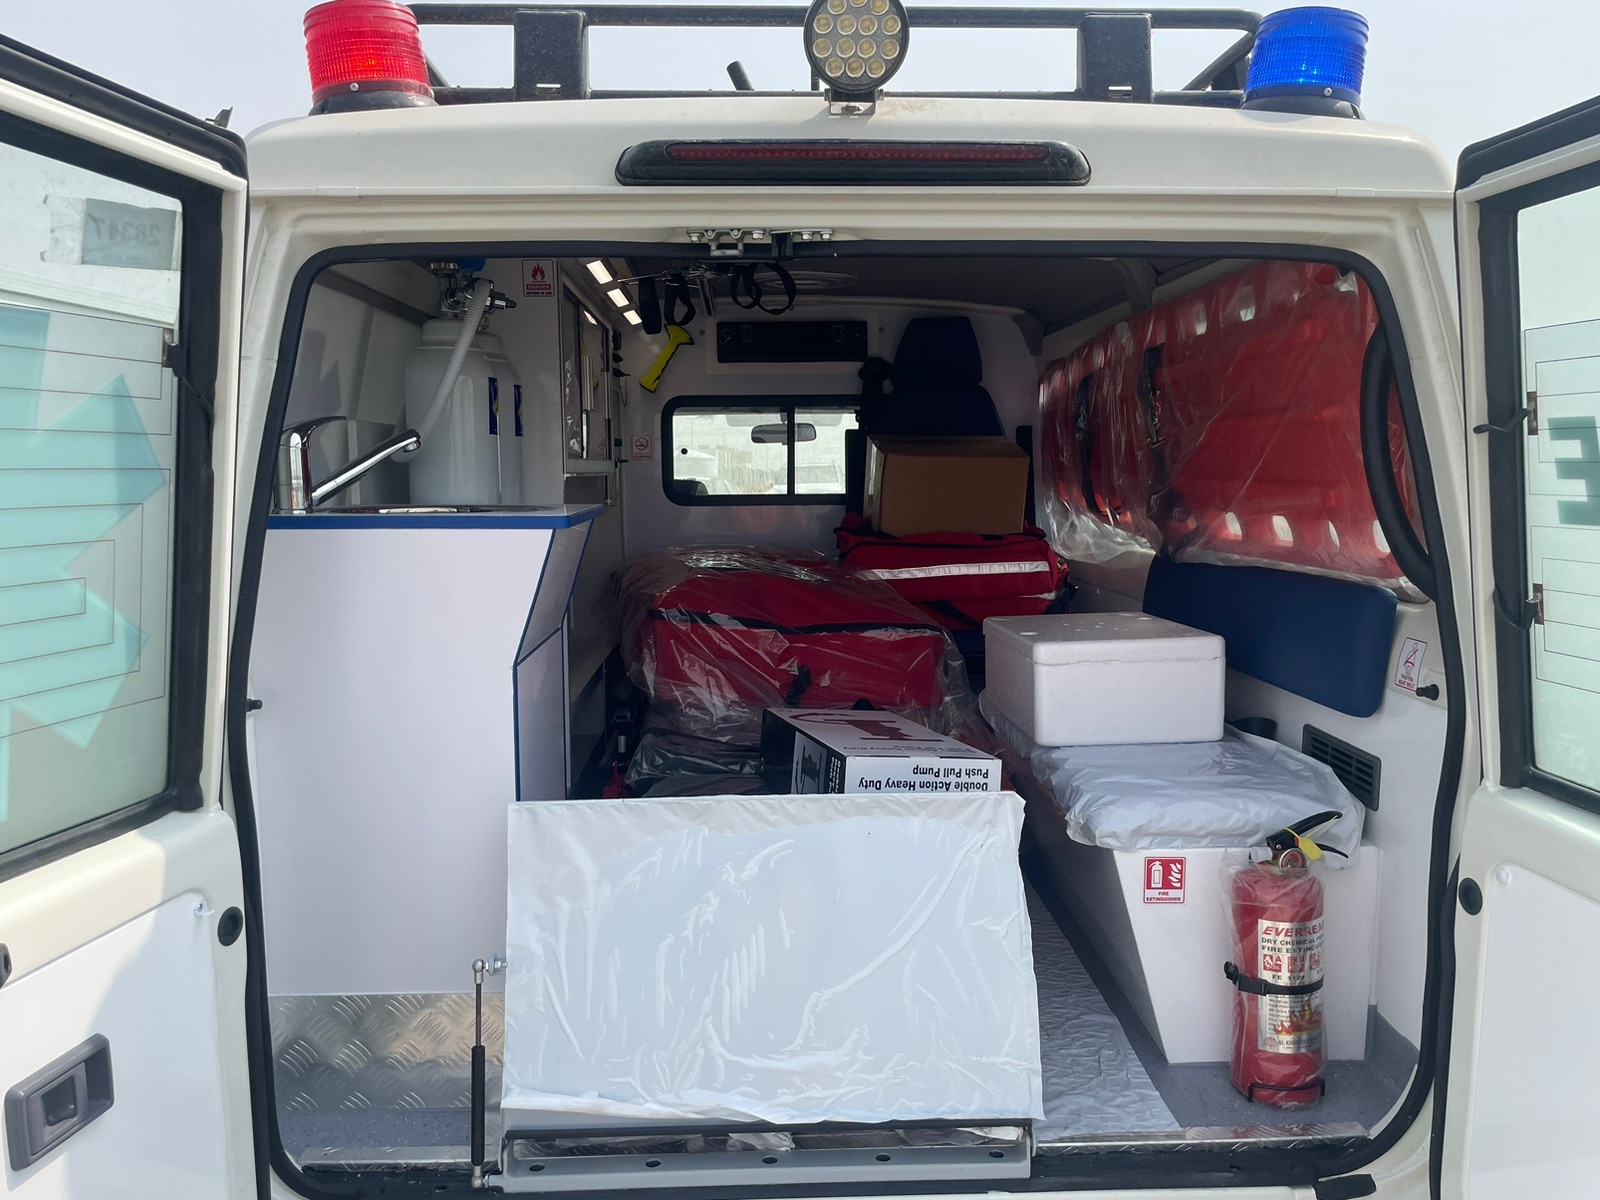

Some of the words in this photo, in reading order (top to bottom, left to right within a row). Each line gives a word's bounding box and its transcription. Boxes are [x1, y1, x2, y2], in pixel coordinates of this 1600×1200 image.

[912, 765, 940, 778] Pump
[943, 767, 962, 778] Pull
[965, 768, 989, 779] Push
[858, 777, 882, 791] Duty
[884, 778, 916, 791] Heavy
[919, 780, 952, 792] Action
[954, 780, 988, 791] Double
[1261, 937, 1277, 945] DRY
[1280, 937, 1315, 946] CHEMICAL
[1261, 945, 1283, 953] FIRE
